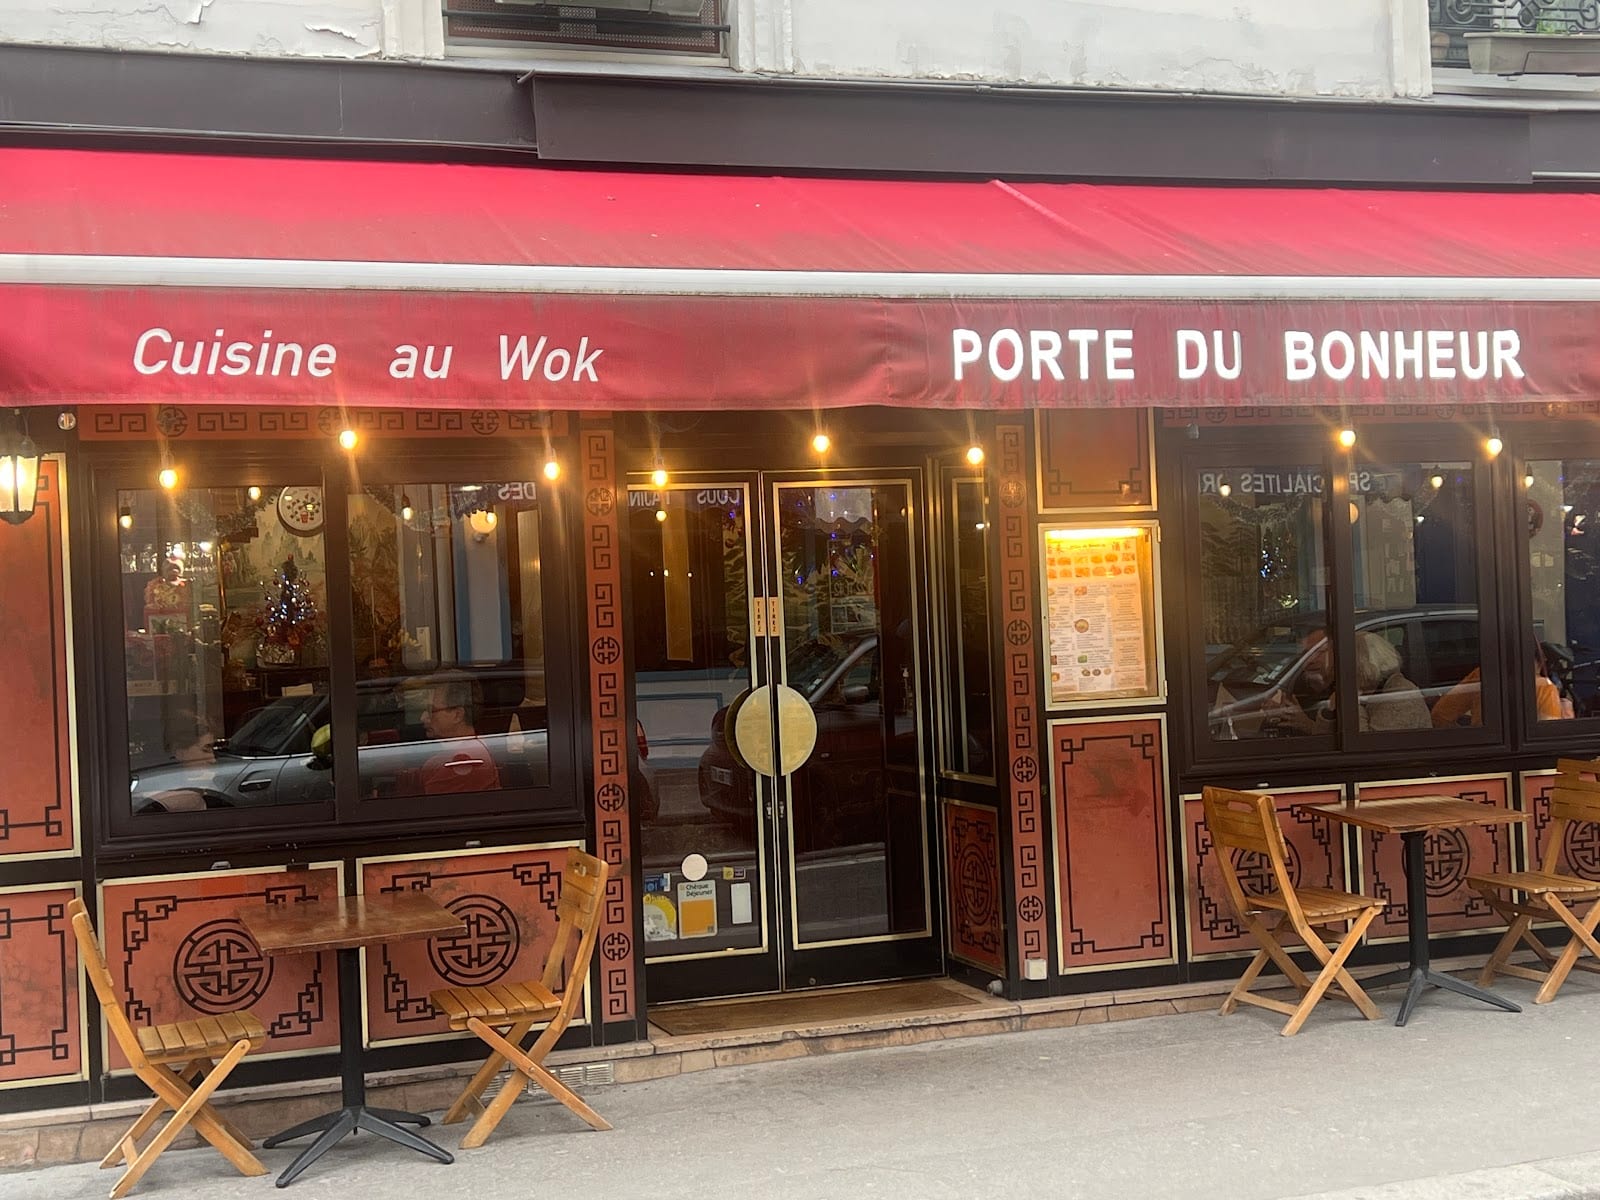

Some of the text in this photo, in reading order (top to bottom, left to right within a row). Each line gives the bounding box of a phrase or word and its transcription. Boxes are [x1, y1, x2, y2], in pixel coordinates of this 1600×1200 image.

[132, 327, 606, 383] Cuisine au Wok
[951, 328, 1525, 382] PORTE DU BONHEUR
